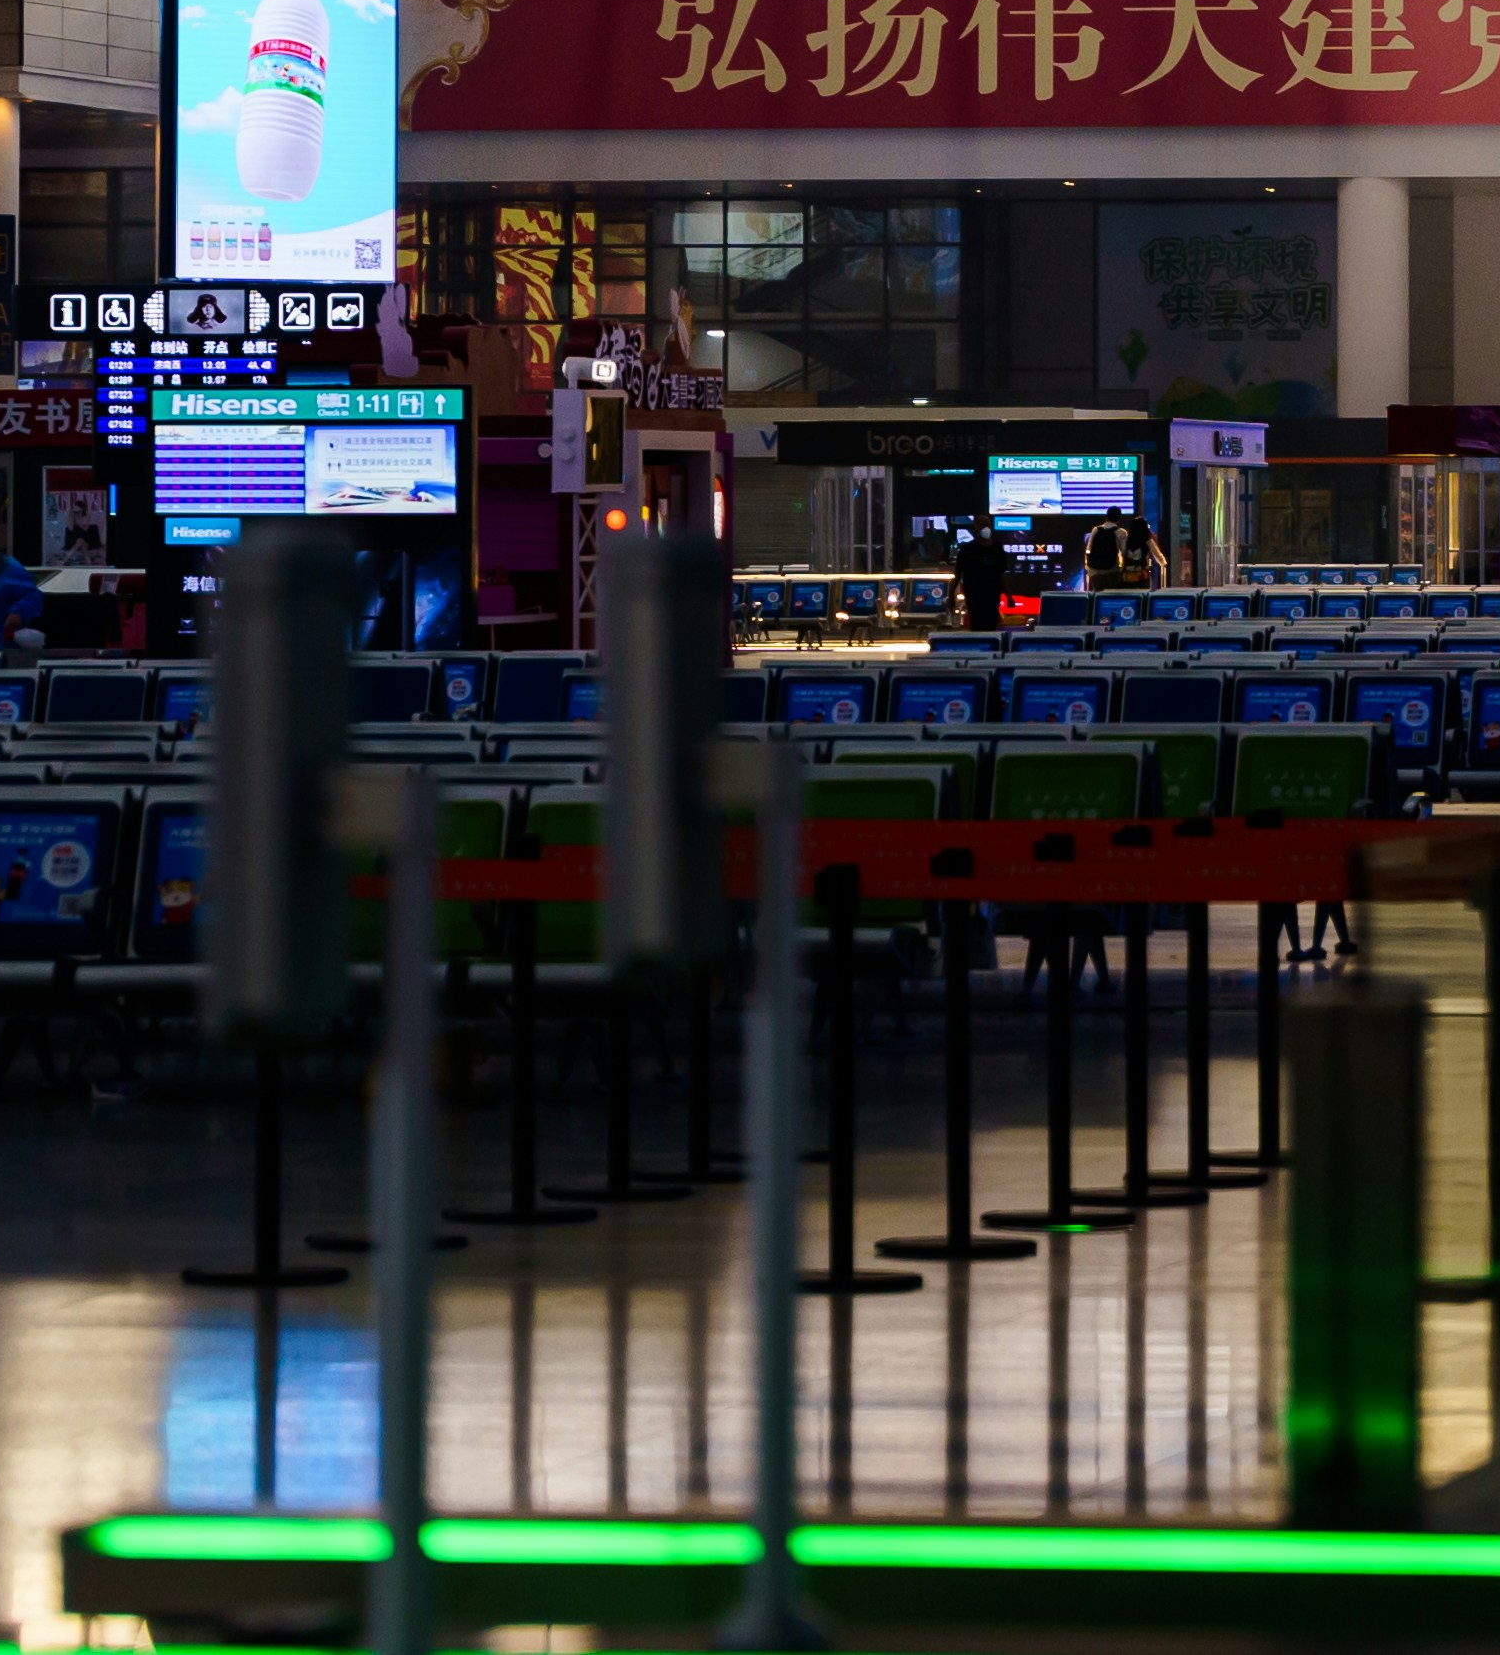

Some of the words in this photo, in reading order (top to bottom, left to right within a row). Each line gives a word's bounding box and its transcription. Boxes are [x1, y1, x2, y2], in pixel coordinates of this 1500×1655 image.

[1140, 235, 1318, 284] 保护环境
[1158, 281, 1331, 330] 共享文明
[171, 393, 298, 415] Hisense
[356, 393, 390, 413] 1-11
[867, 430, 935, 456] breo
[998, 457, 1059, 469] Hisense
[172, 526, 232, 539] Hisense
